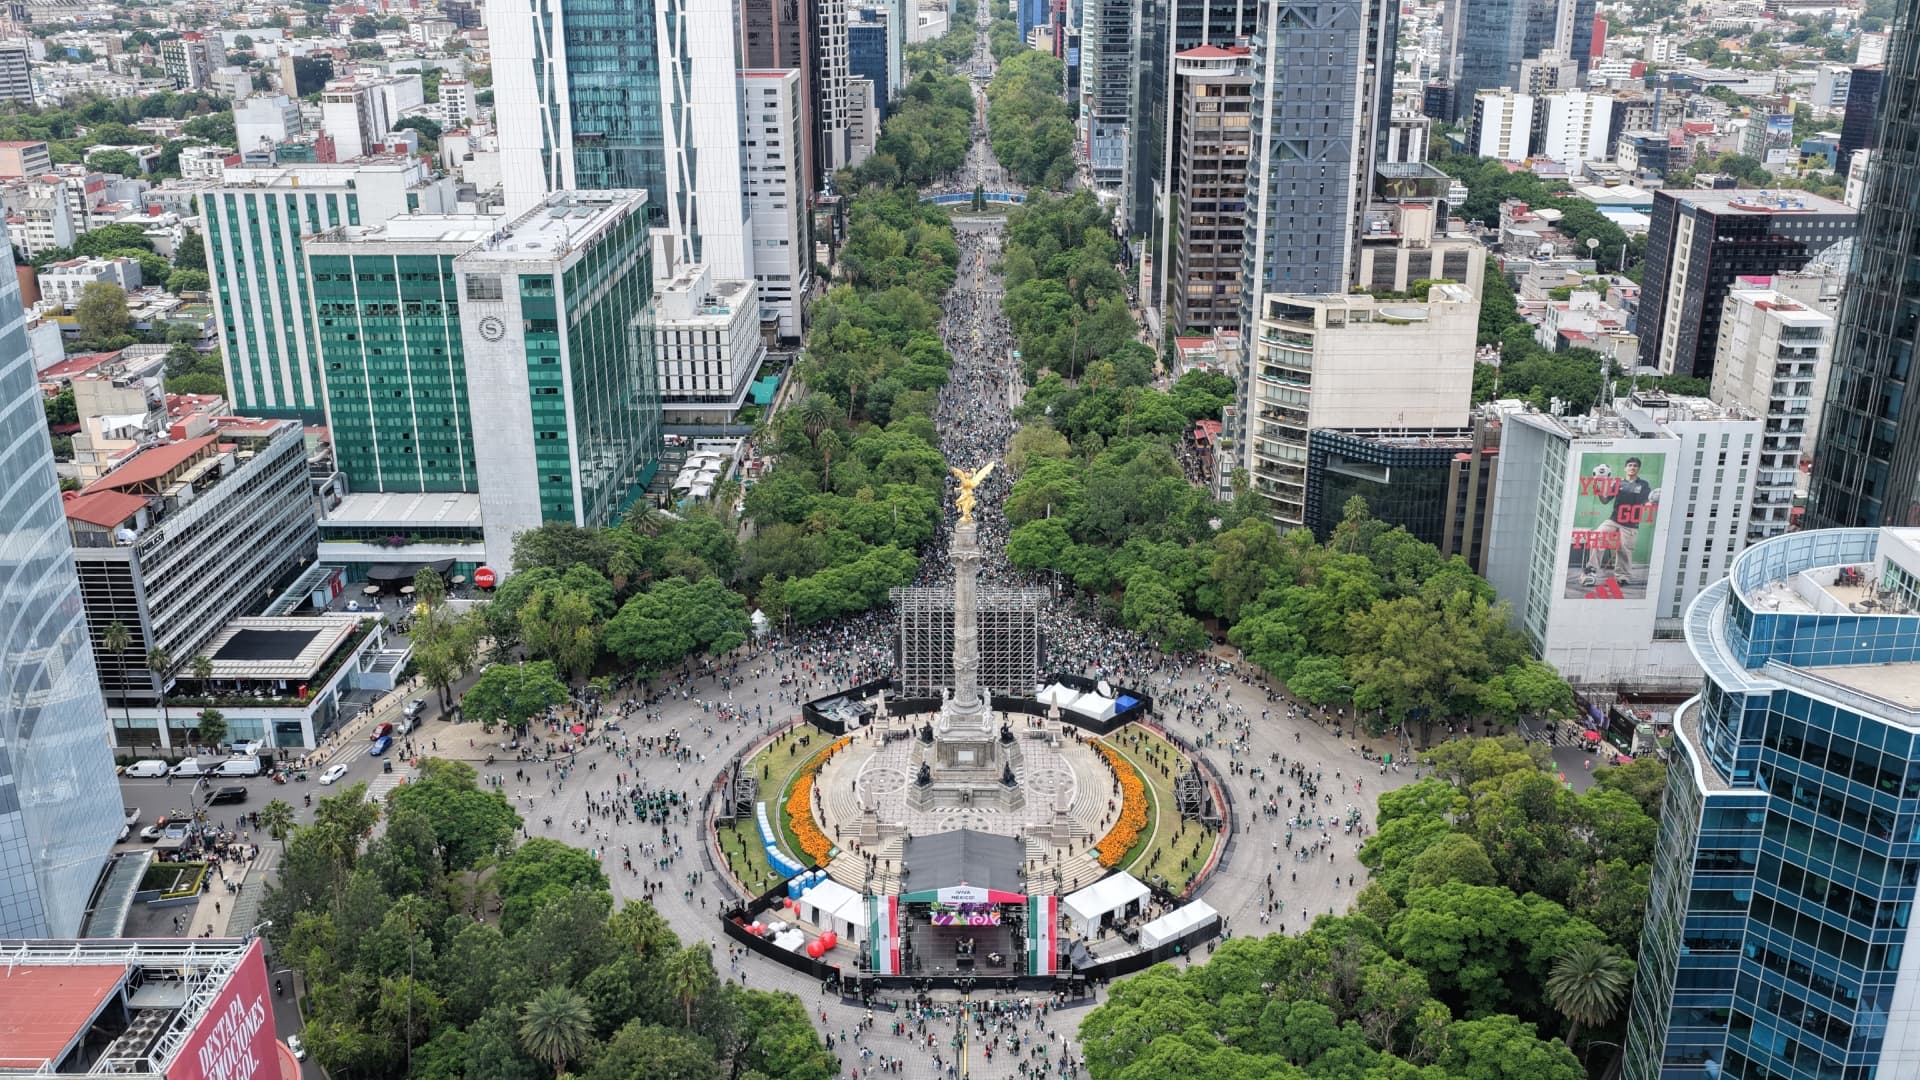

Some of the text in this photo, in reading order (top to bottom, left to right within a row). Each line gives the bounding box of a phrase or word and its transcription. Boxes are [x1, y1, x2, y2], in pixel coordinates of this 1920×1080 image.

[486, 323, 496, 335] S
[1579, 477, 1621, 496] YOU
[1617, 504, 1659, 523] GOT
[1572, 531, 1621, 550] THIS
[198, 993, 245, 1078] DESTAPA
